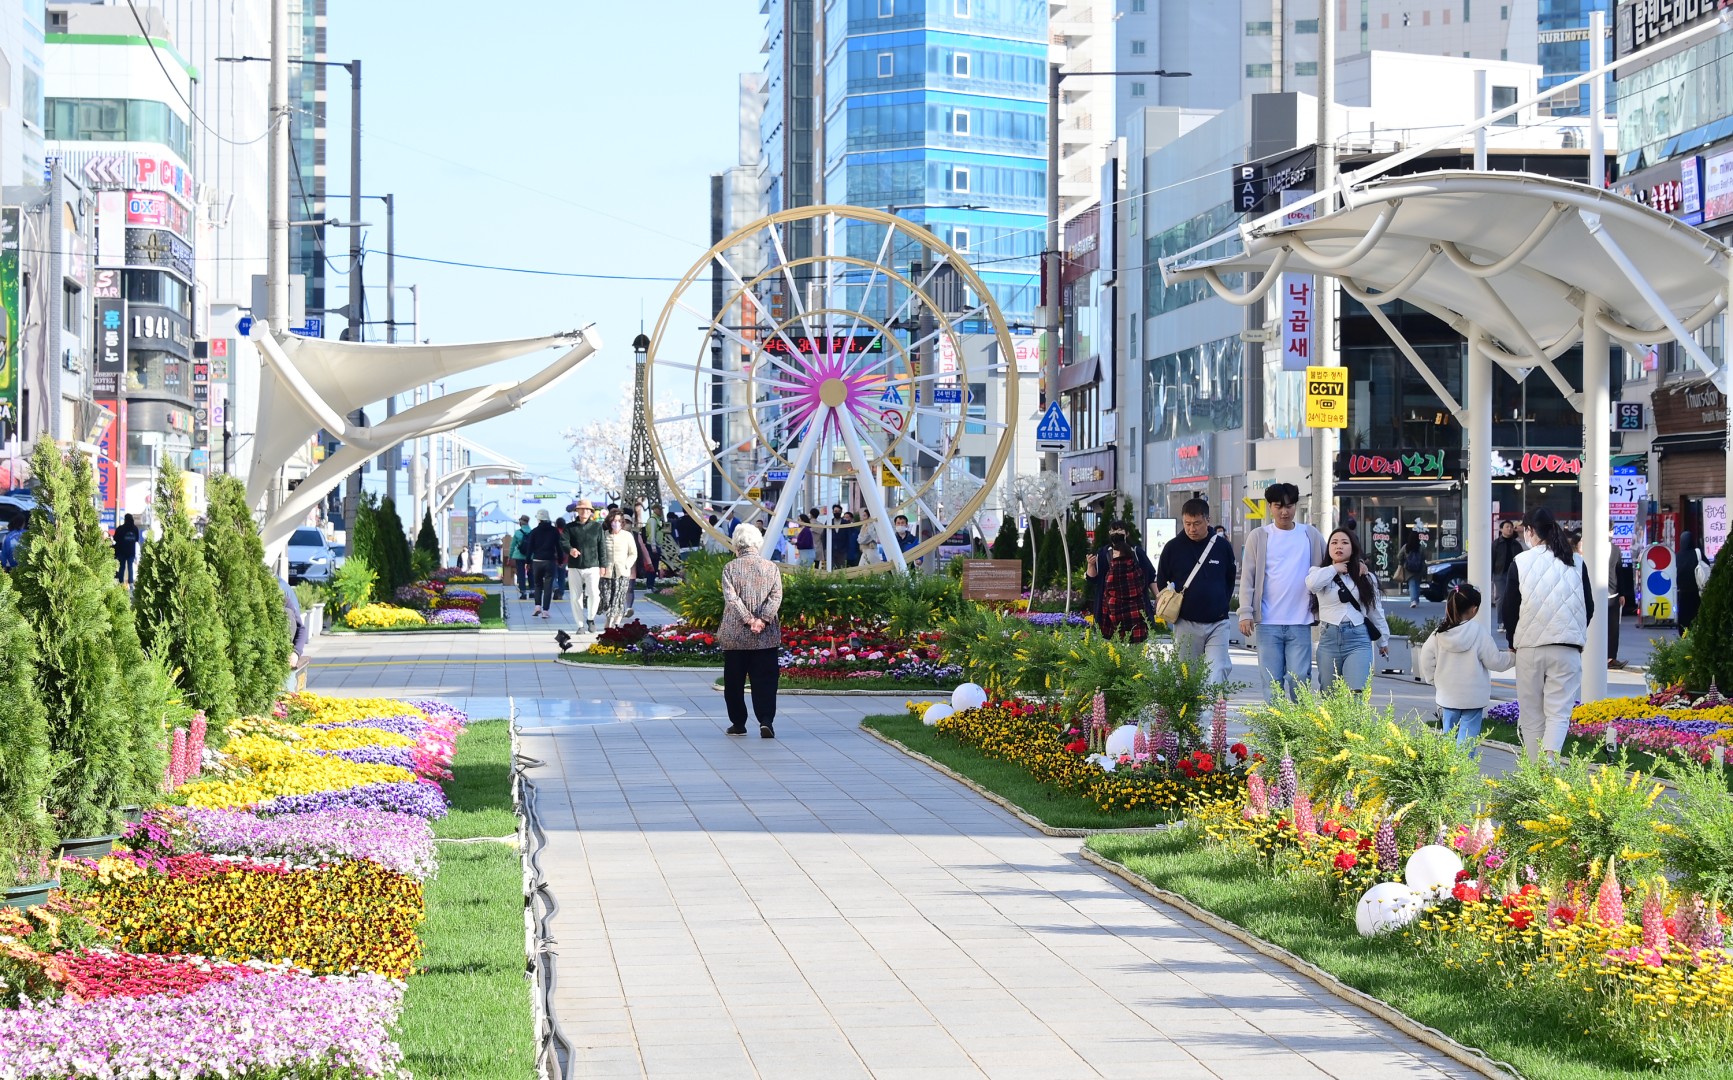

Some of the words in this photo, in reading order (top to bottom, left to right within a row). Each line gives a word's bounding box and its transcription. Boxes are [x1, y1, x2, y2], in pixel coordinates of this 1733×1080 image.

[1242, 166, 1255, 208] BAR
[134, 315, 169, 339] 1943
[1288, 283, 1310, 358] 낙곱새
[1310, 383, 1342, 394] CCTV
[1308, 413, 1326, 422] 24시간
[1622, 405, 1638, 416] GS
[1622, 416, 1638, 428] 25
[1521, 452, 1580, 476] 100세
[1650, 602, 1669, 616] 7F
